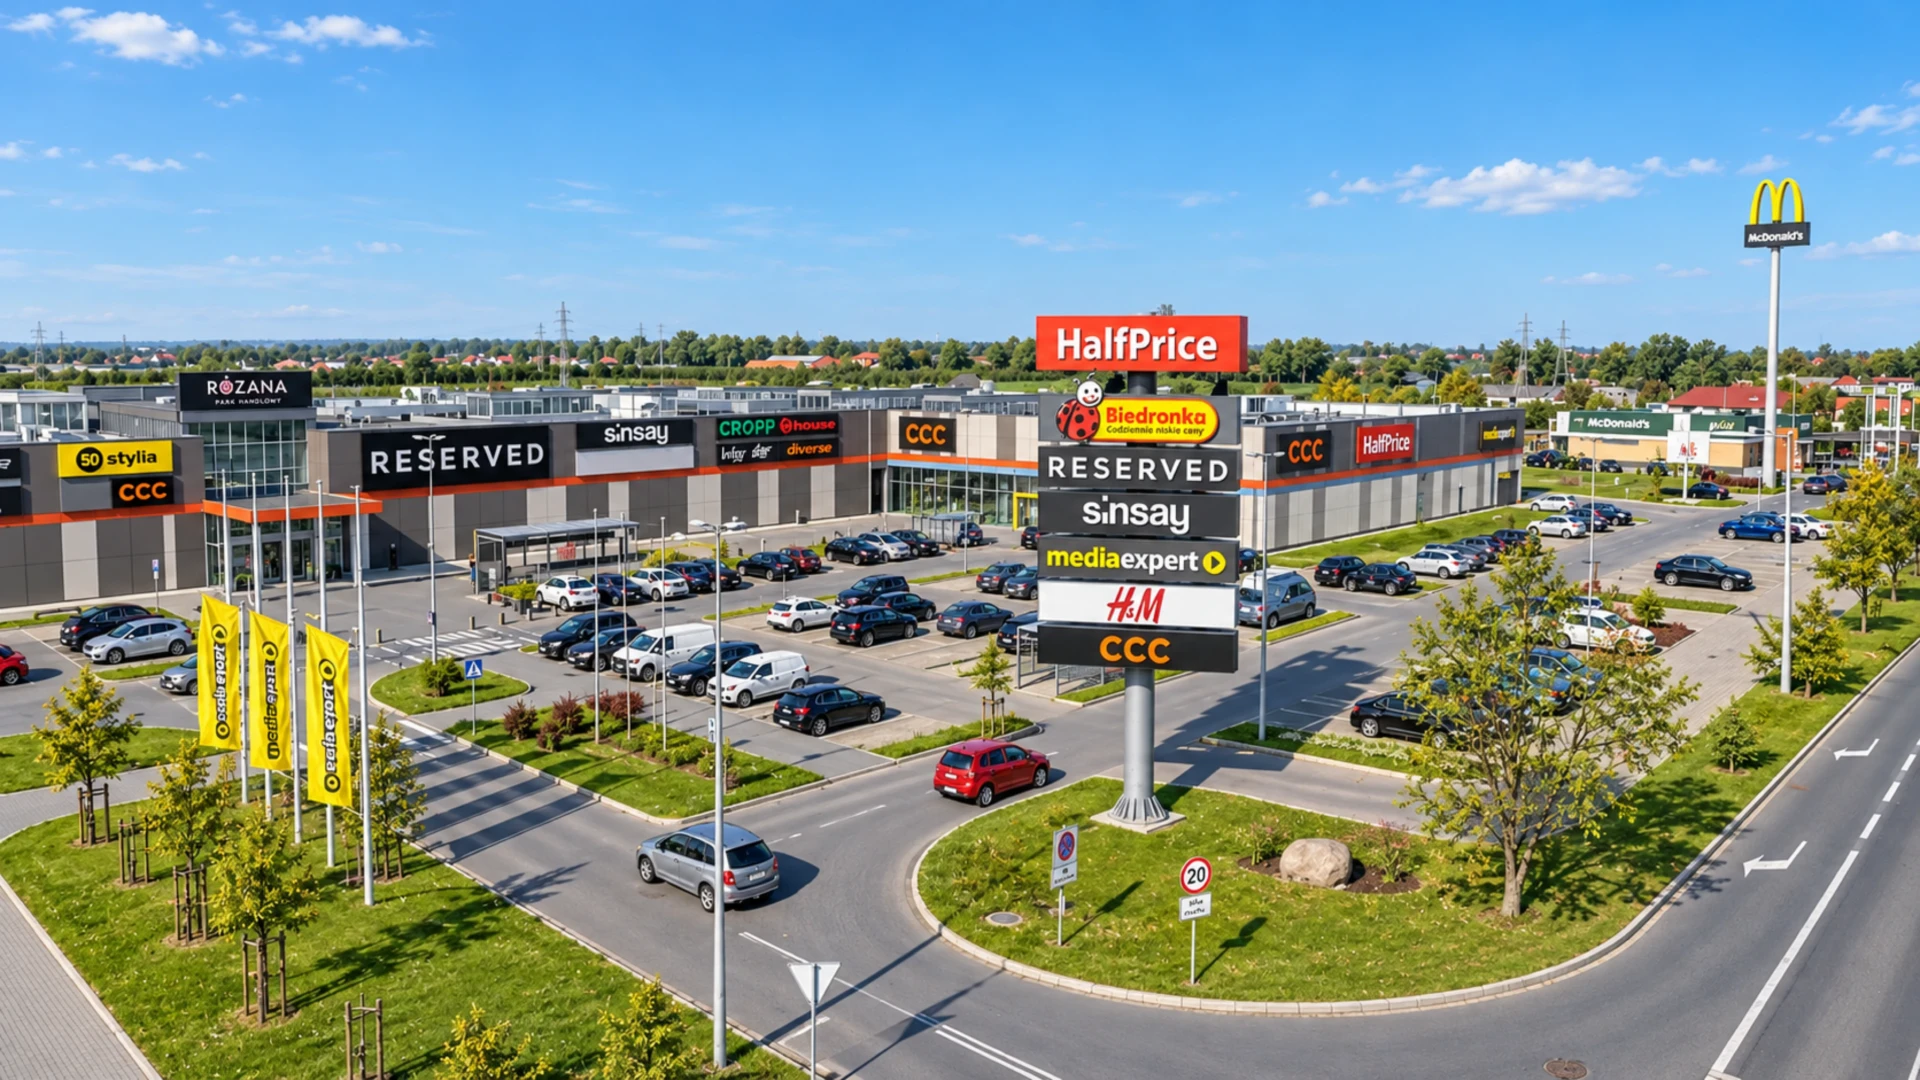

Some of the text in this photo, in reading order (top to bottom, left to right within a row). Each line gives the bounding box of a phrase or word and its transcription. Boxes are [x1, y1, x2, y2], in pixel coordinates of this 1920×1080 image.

[1748, 231, 1803, 242] McDonald's
[1057, 327, 1218, 361] HalfPrice
[1106, 406, 1206, 425] Biedronka
[1587, 418, 1650, 429] McDonald's
[604, 423, 668, 445] sinsay
[719, 419, 836, 436] CROPP house
[906, 423, 946, 445] CCC
[787, 442, 832, 455] diverse
[1288, 438, 1323, 463] CCC
[1363, 433, 1410, 455] HalfPrice
[81, 450, 157, 467] 50 stylia
[371, 443, 544, 475] RESERVED
[1048, 456, 1228, 482] RESERVED
[118, 482, 167, 501] CCC
[1082, 495, 1190, 535] sinsay
[1047, 547, 1199, 575] mediaexpert
[1107, 586, 1166, 624] H&M
[1099, 635, 1171, 665] CCC
[1187, 866, 1206, 885] 20
